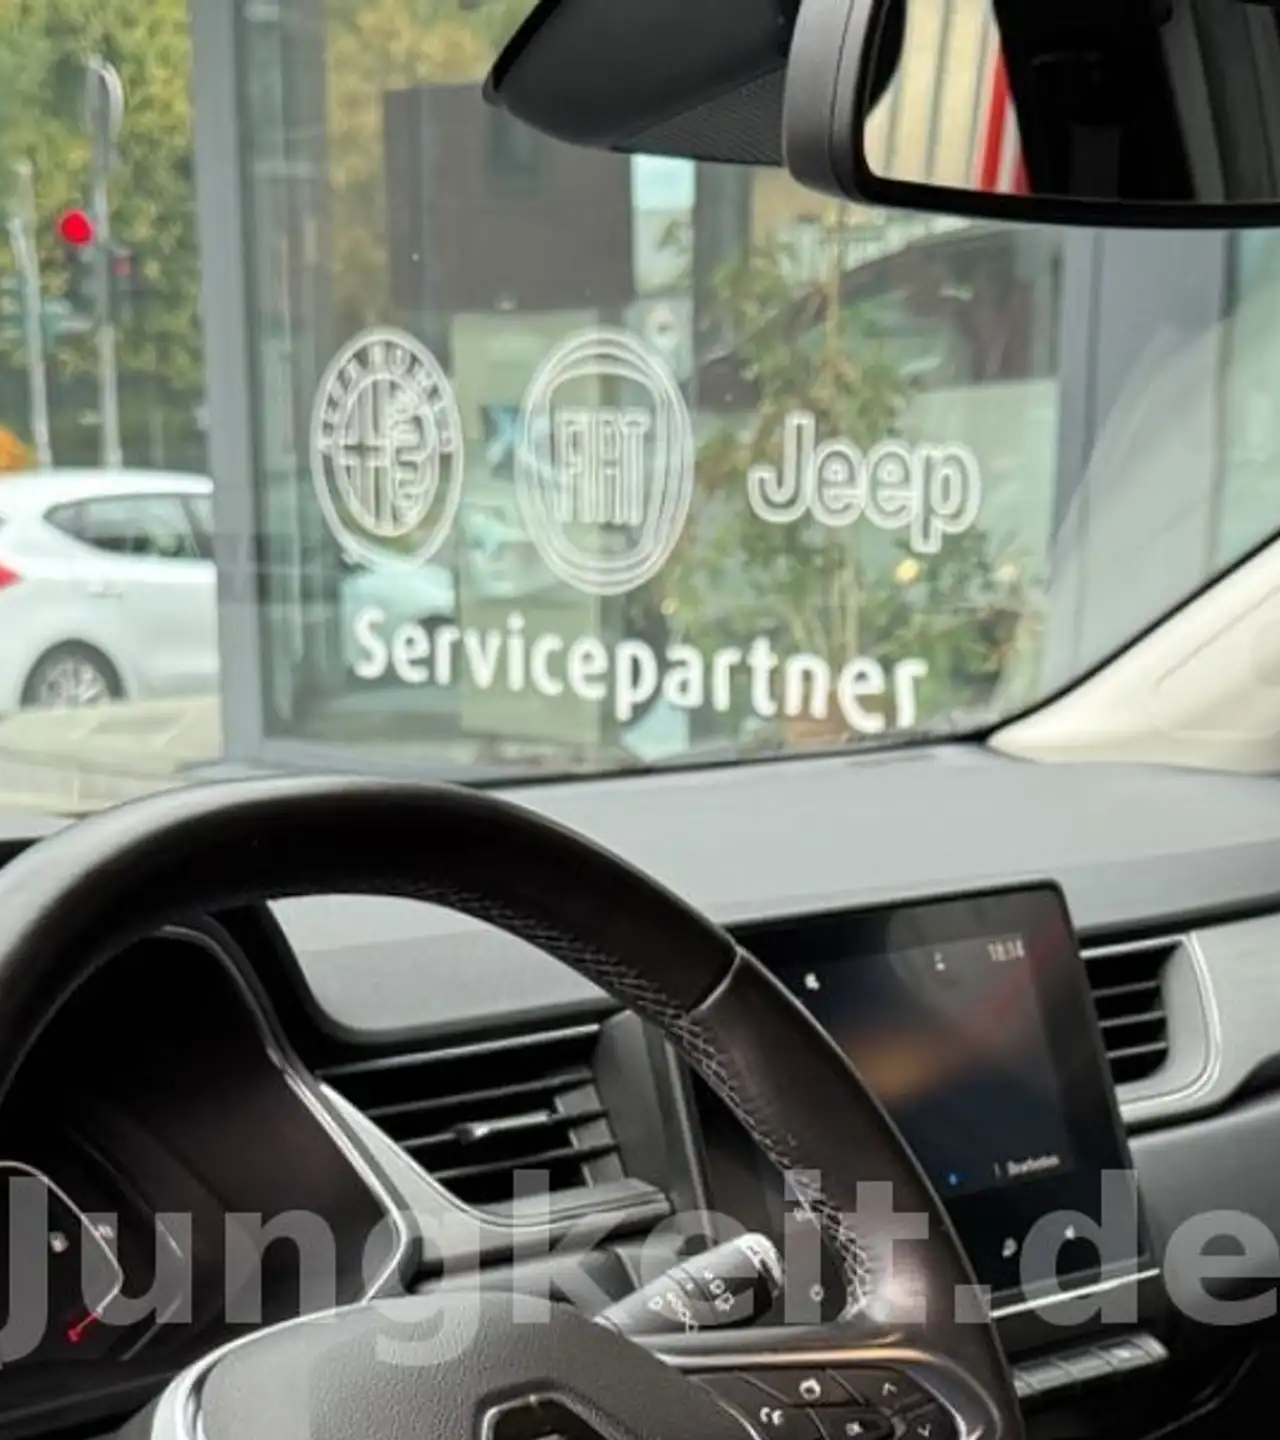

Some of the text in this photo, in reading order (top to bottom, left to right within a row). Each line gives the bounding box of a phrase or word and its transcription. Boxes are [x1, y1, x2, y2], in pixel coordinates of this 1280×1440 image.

[554, 406, 652, 526] FIAT
[747, 410, 982, 554] Jeep
[352, 604, 929, 734] Servicepartner
